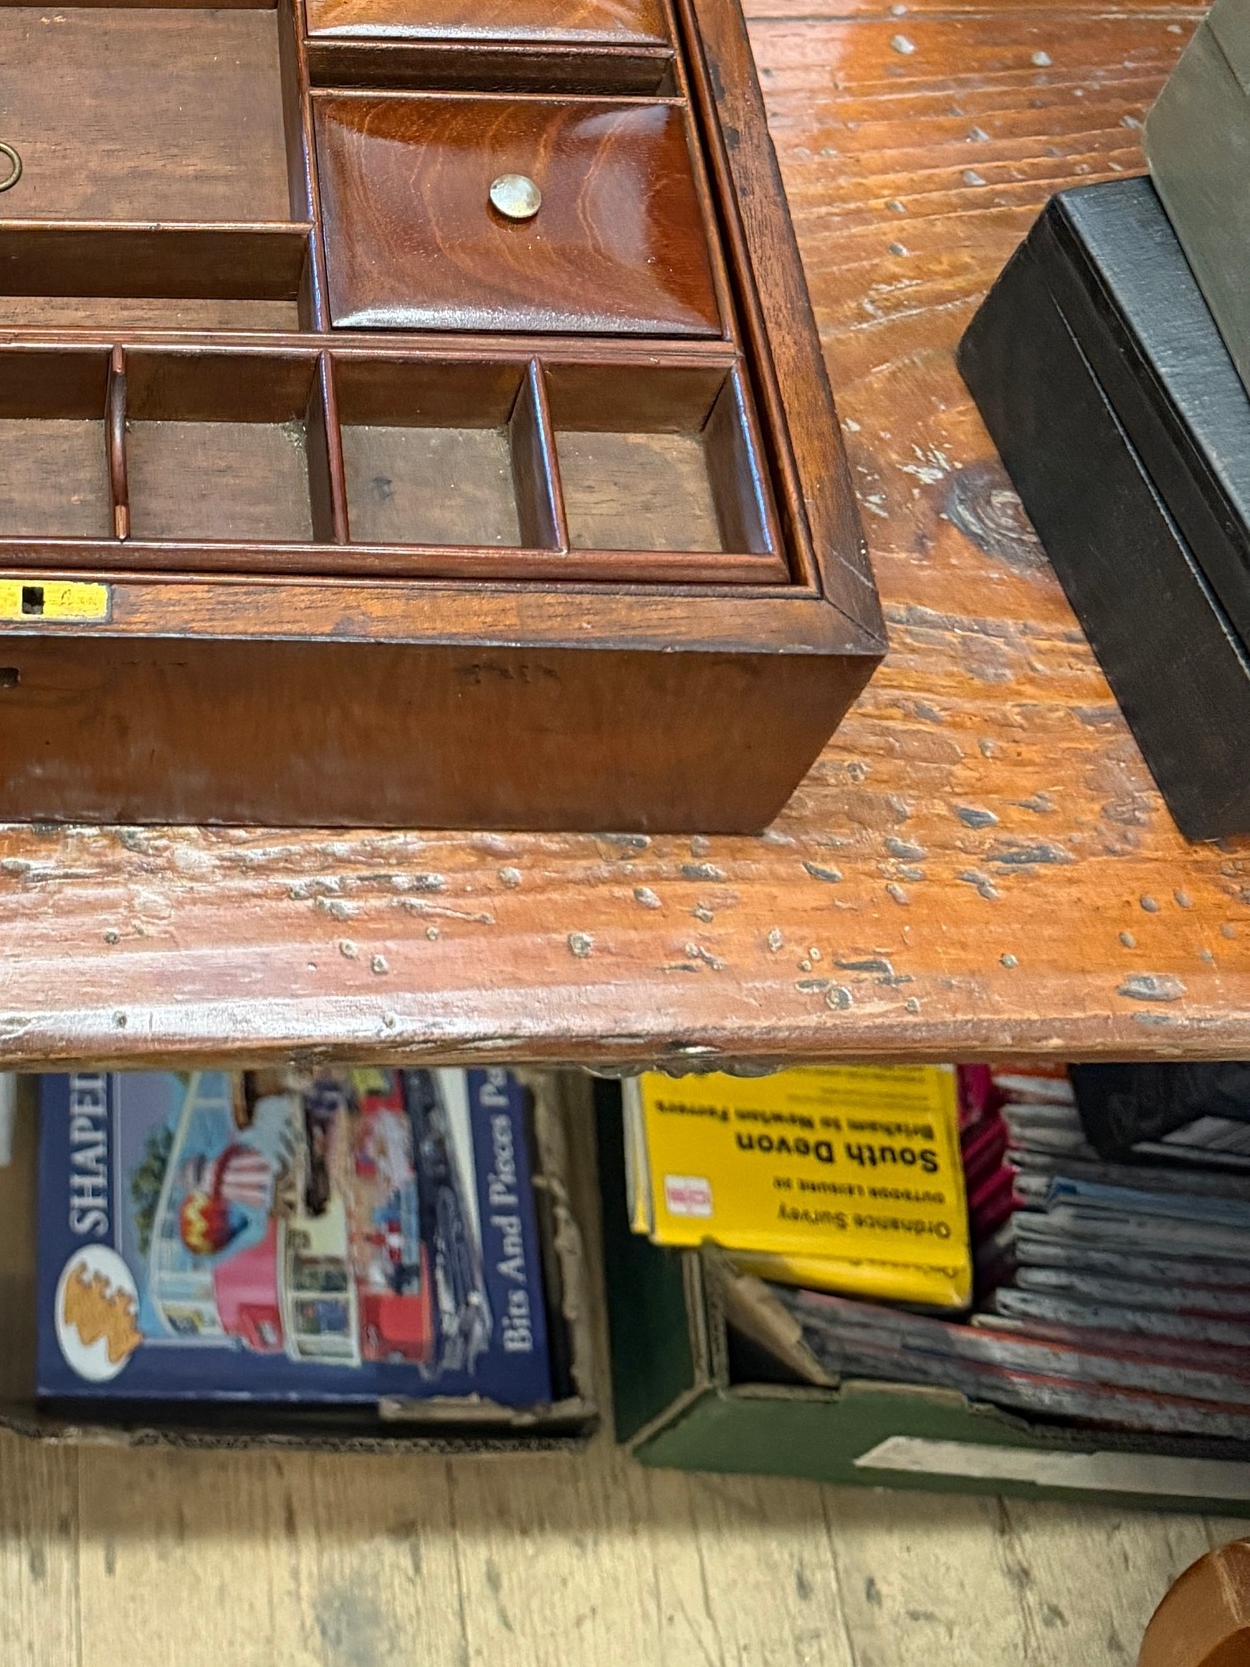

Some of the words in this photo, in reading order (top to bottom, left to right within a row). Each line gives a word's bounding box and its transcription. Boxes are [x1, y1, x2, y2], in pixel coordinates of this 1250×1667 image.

[819, 1117, 841, 1133] to
[736, 1133, 835, 1164] Devon
[845, 1142, 938, 1174] South
[777, 1202, 849, 1230] Survey
[853, 1213, 952, 1240] Ordnance
[490, 1215, 526, 1283] And
[501, 1289, 534, 1353] Bits
